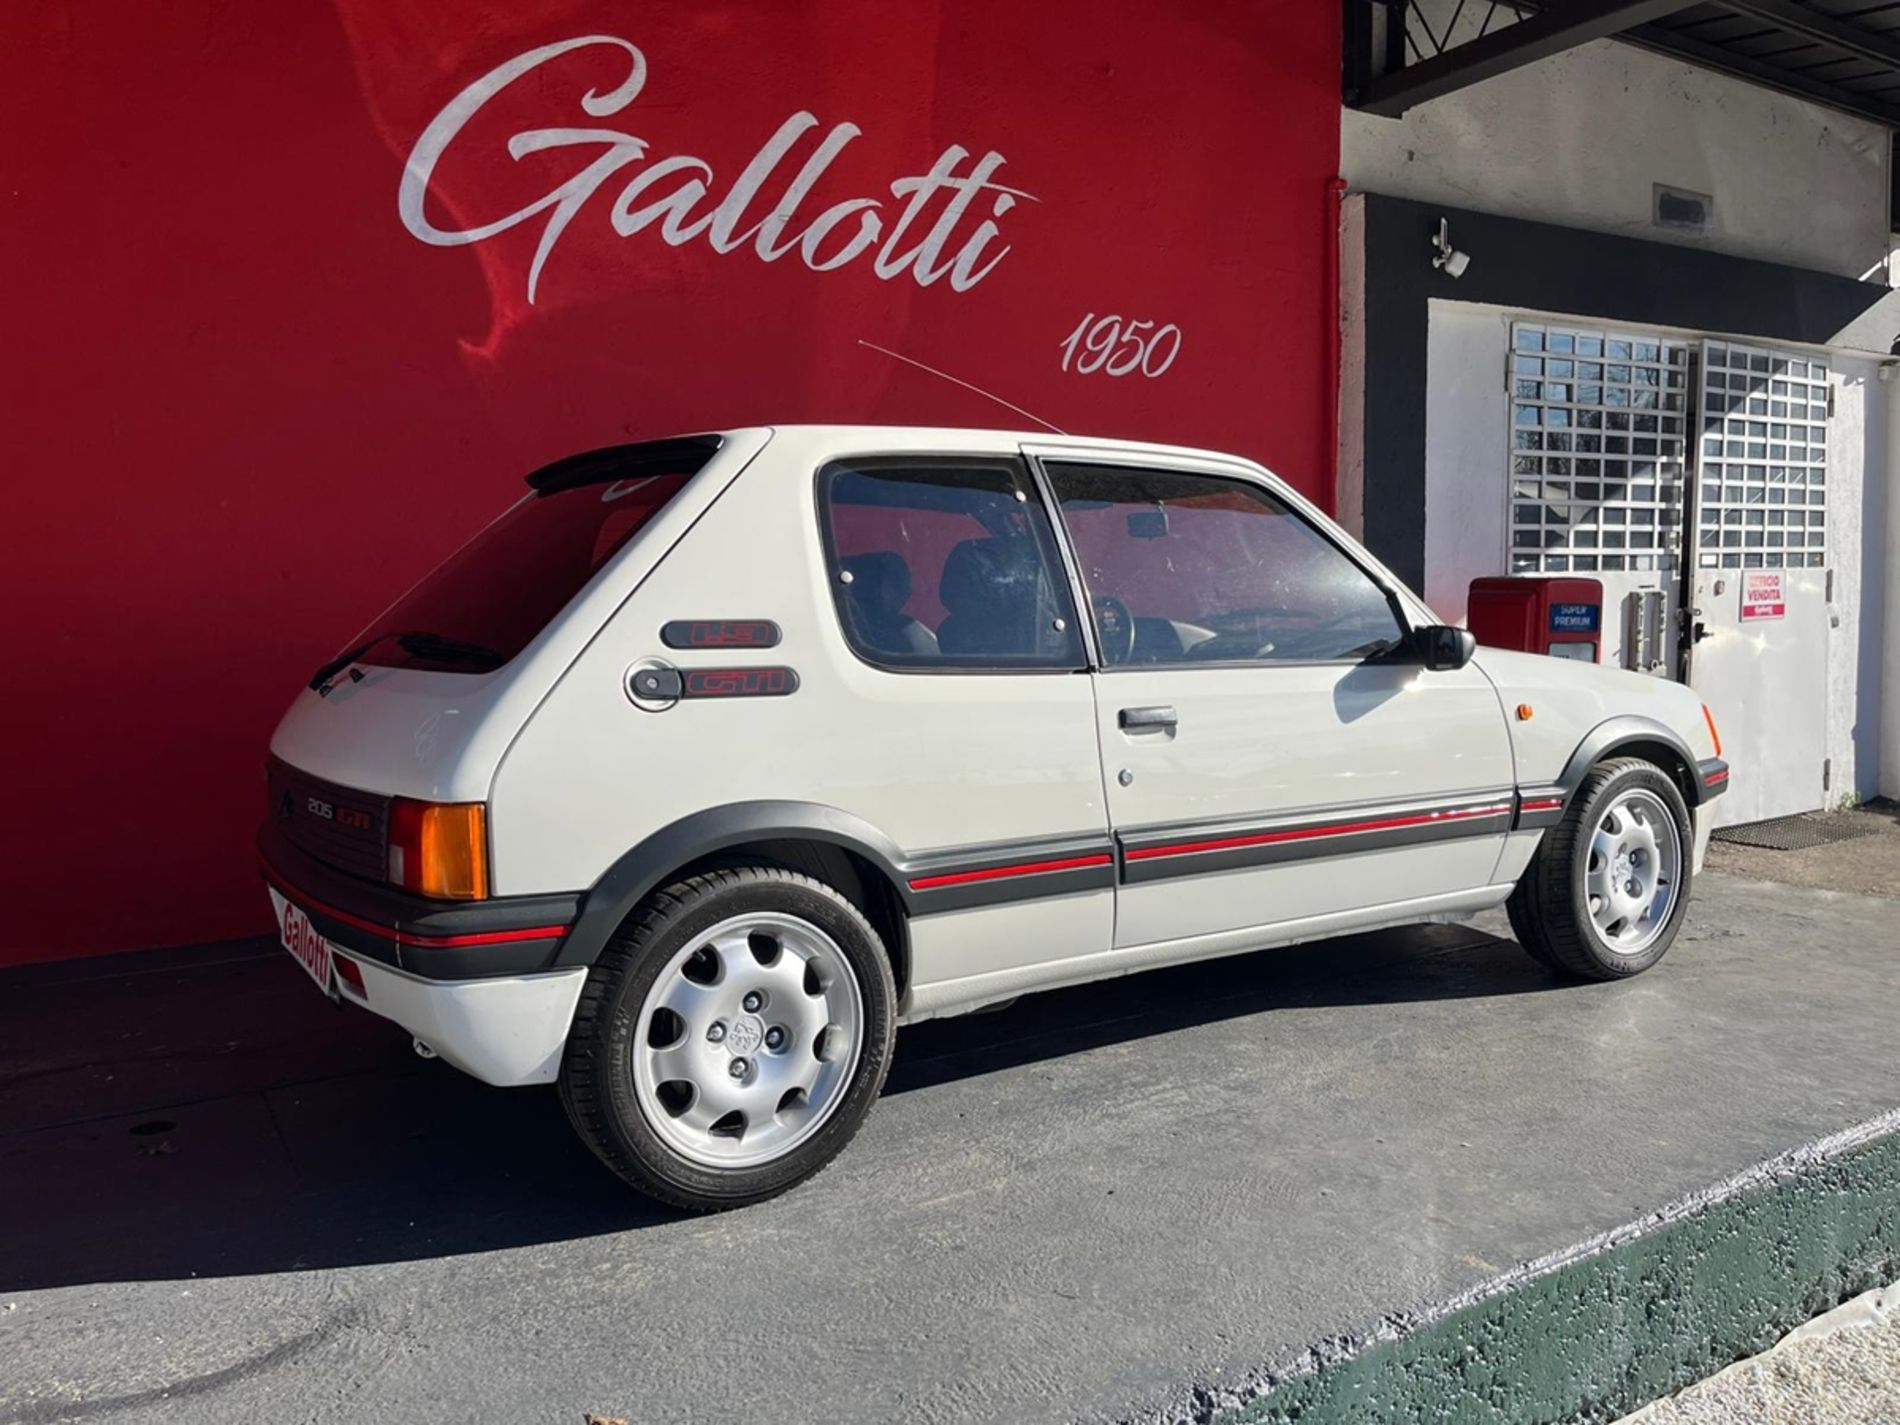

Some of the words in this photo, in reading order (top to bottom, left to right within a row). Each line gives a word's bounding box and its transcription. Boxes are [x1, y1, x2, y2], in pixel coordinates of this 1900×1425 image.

[398, 35, 1042, 305] Gallotti
[1059, 313, 1182, 378] 1950
[1747, 588, 1781, 601] VENDITA
[1560, 604, 1587, 615] SUPER
[1553, 616, 1591, 627] PREMIUM
[307, 797, 333, 819] 205
[284, 902, 329, 987] Gallotti
